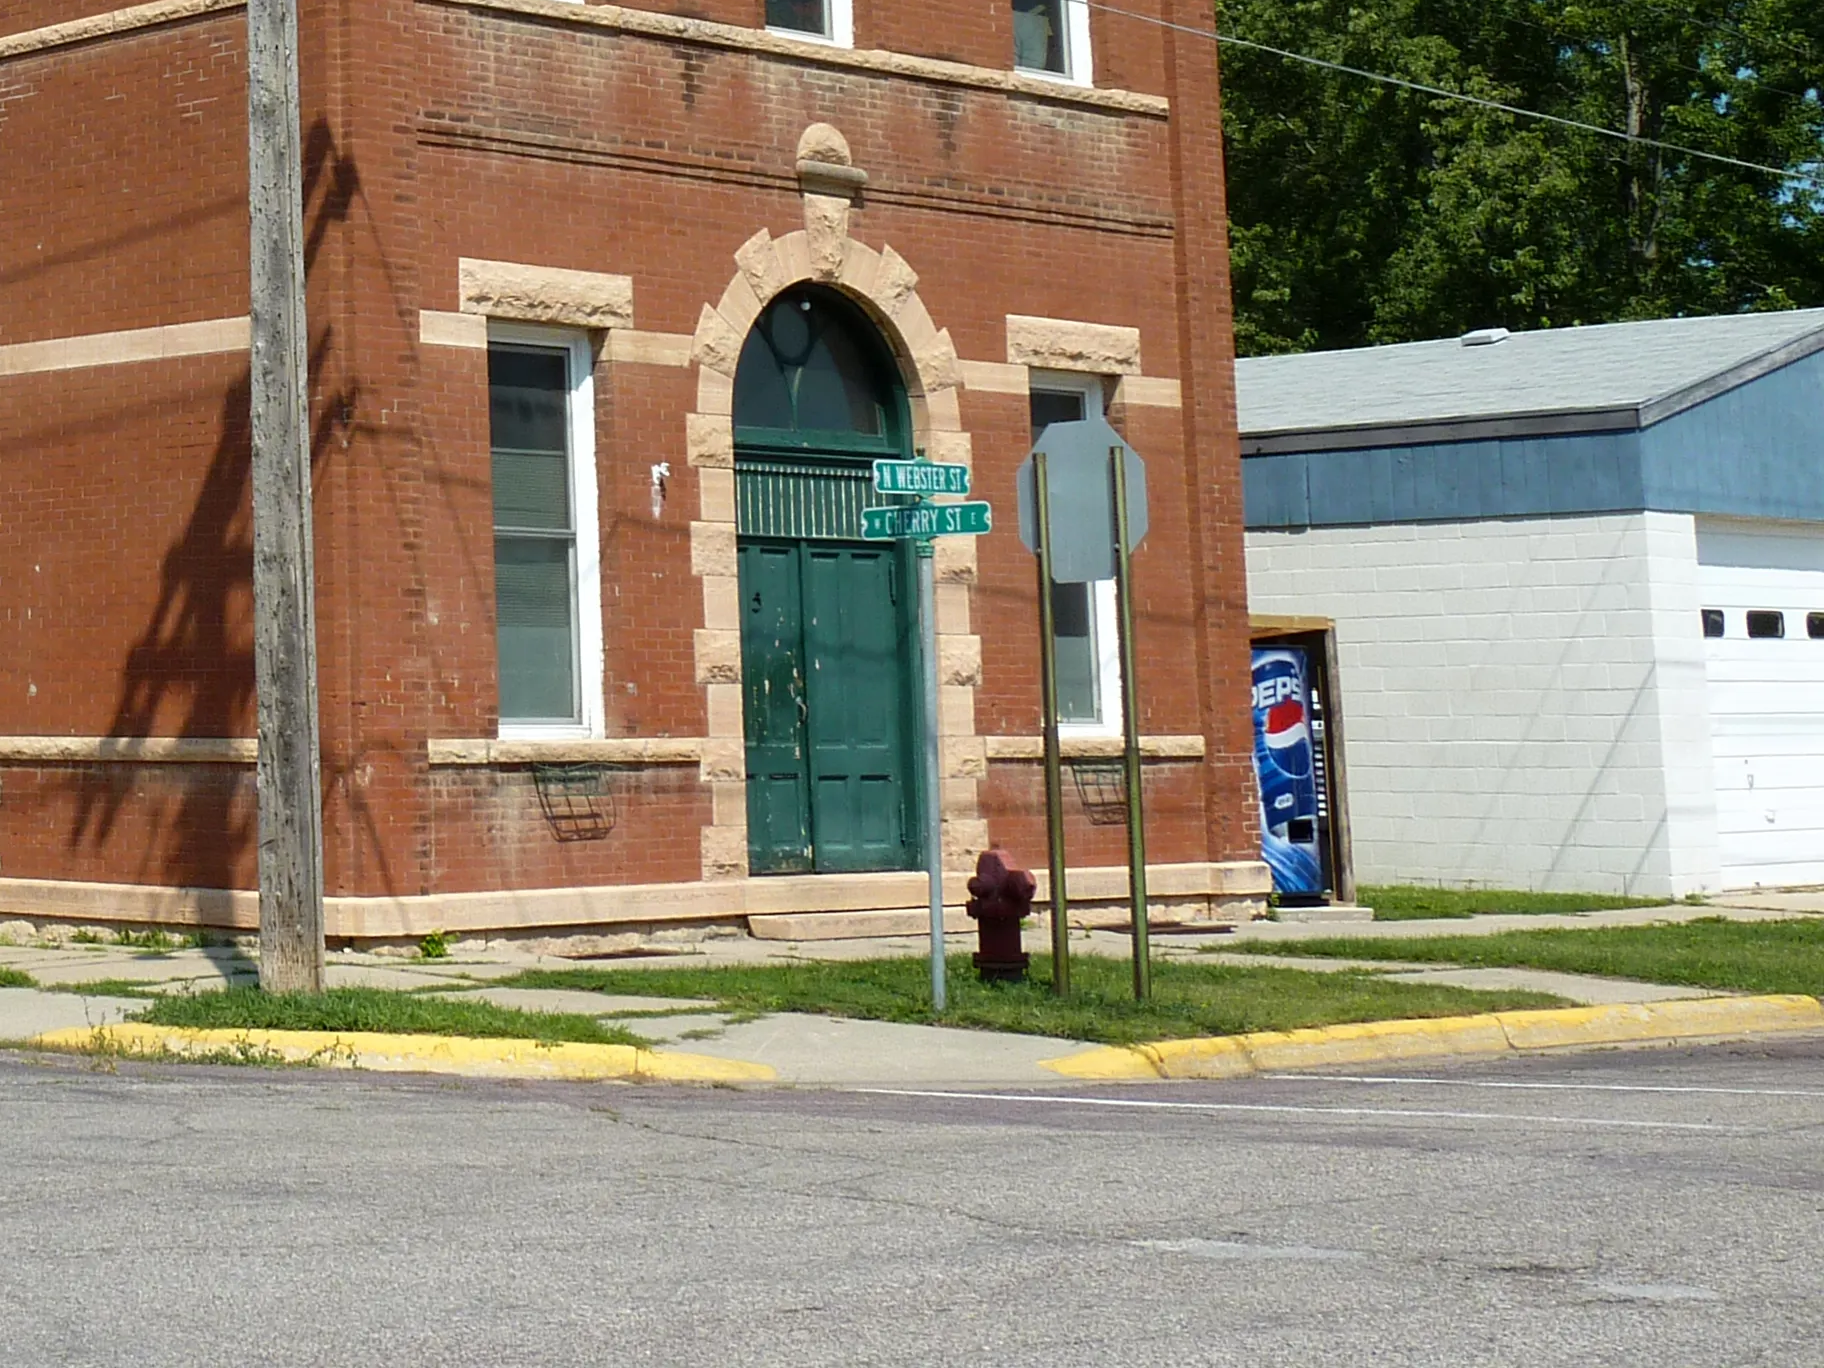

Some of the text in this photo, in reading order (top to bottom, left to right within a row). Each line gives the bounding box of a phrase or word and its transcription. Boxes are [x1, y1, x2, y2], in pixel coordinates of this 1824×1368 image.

[882, 465, 962, 491] N WEBSTER ST
[885, 508, 938, 534] CHERRY
[945, 507, 962, 532] ST
[970, 511, 977, 525] E
